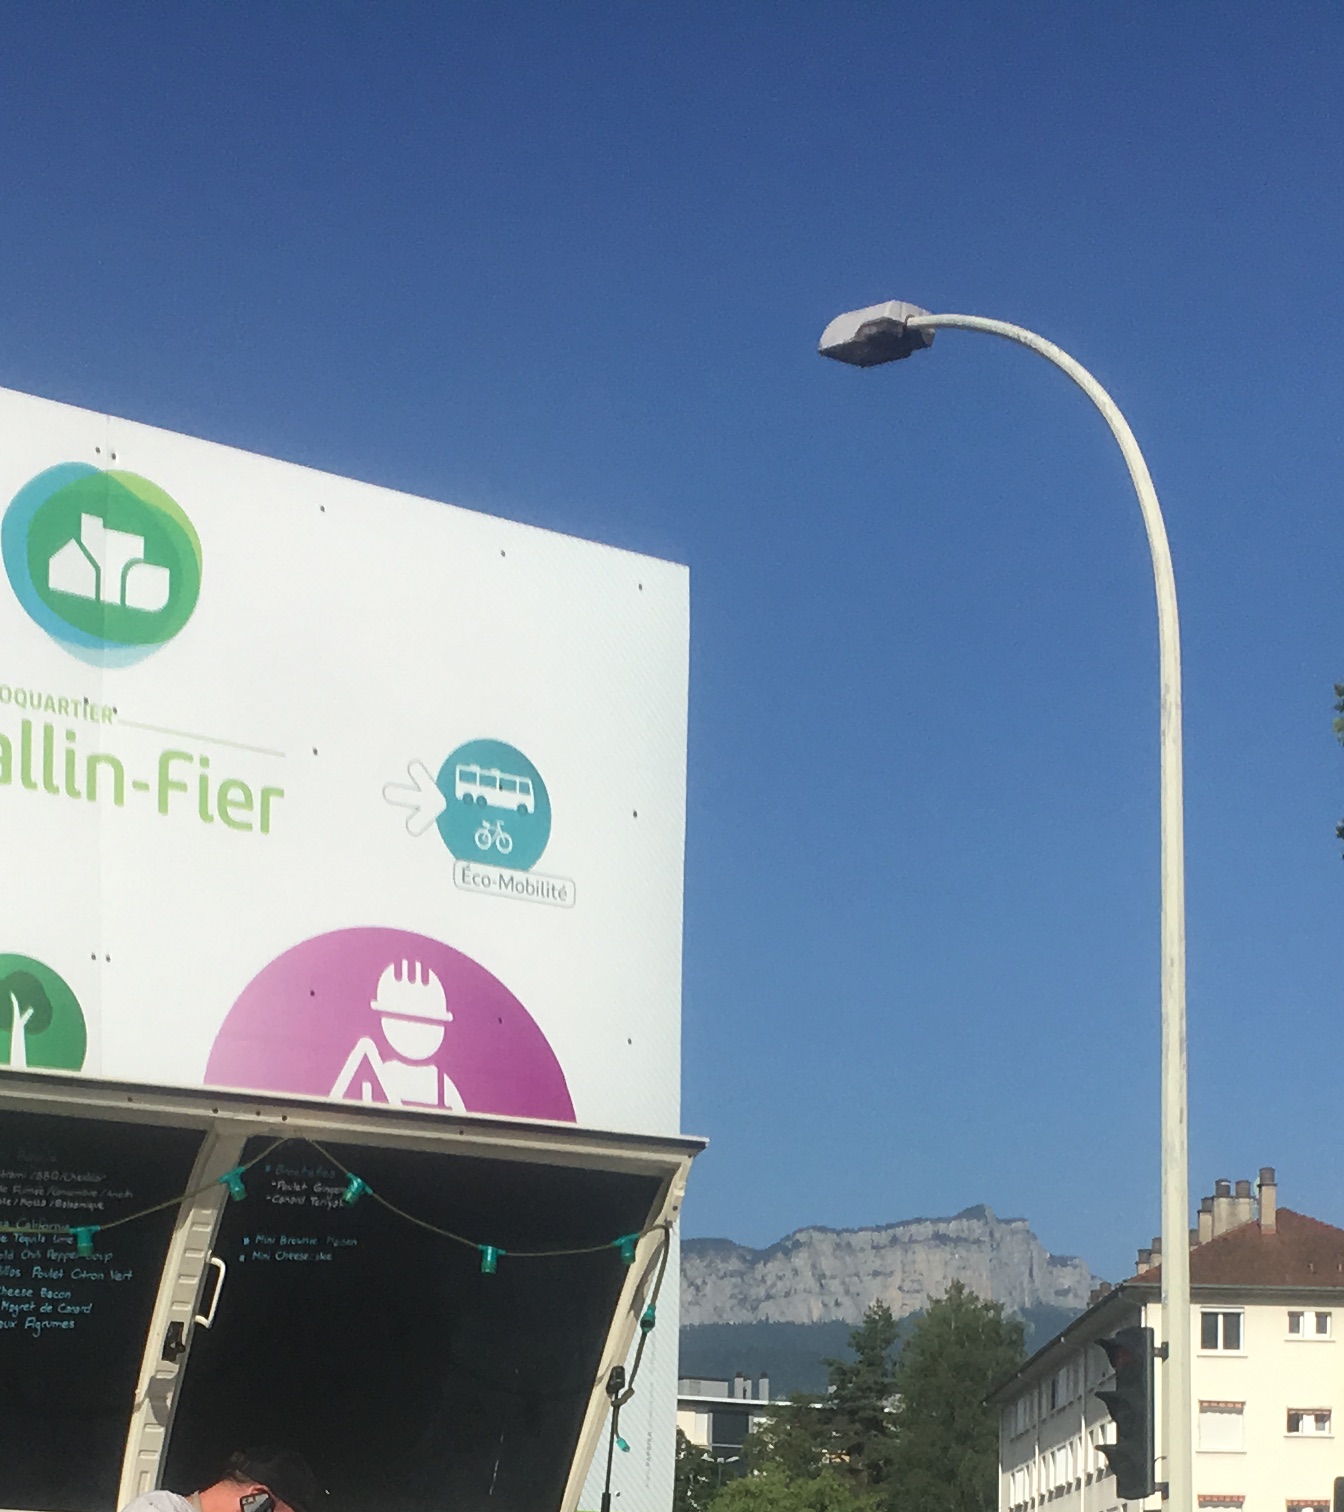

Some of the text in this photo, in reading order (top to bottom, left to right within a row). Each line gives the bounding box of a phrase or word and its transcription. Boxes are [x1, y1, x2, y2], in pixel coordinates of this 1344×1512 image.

[459, 864, 569, 903] Éco-Mobilité
[13, 1232, 47, 1246] Tequila
[31, 1265, 64, 1279] Poulet
[70, 1268, 105, 1281] Citron
[109, 1269, 133, 1281] Vert
[40, 1287, 72, 1299] Bacon
[0, 1300, 36, 1318] Magret
[40, 1301, 54, 1314] de
[57, 1302, 93, 1315] Canard
[24, 1316, 75, 1338] Agrumes
